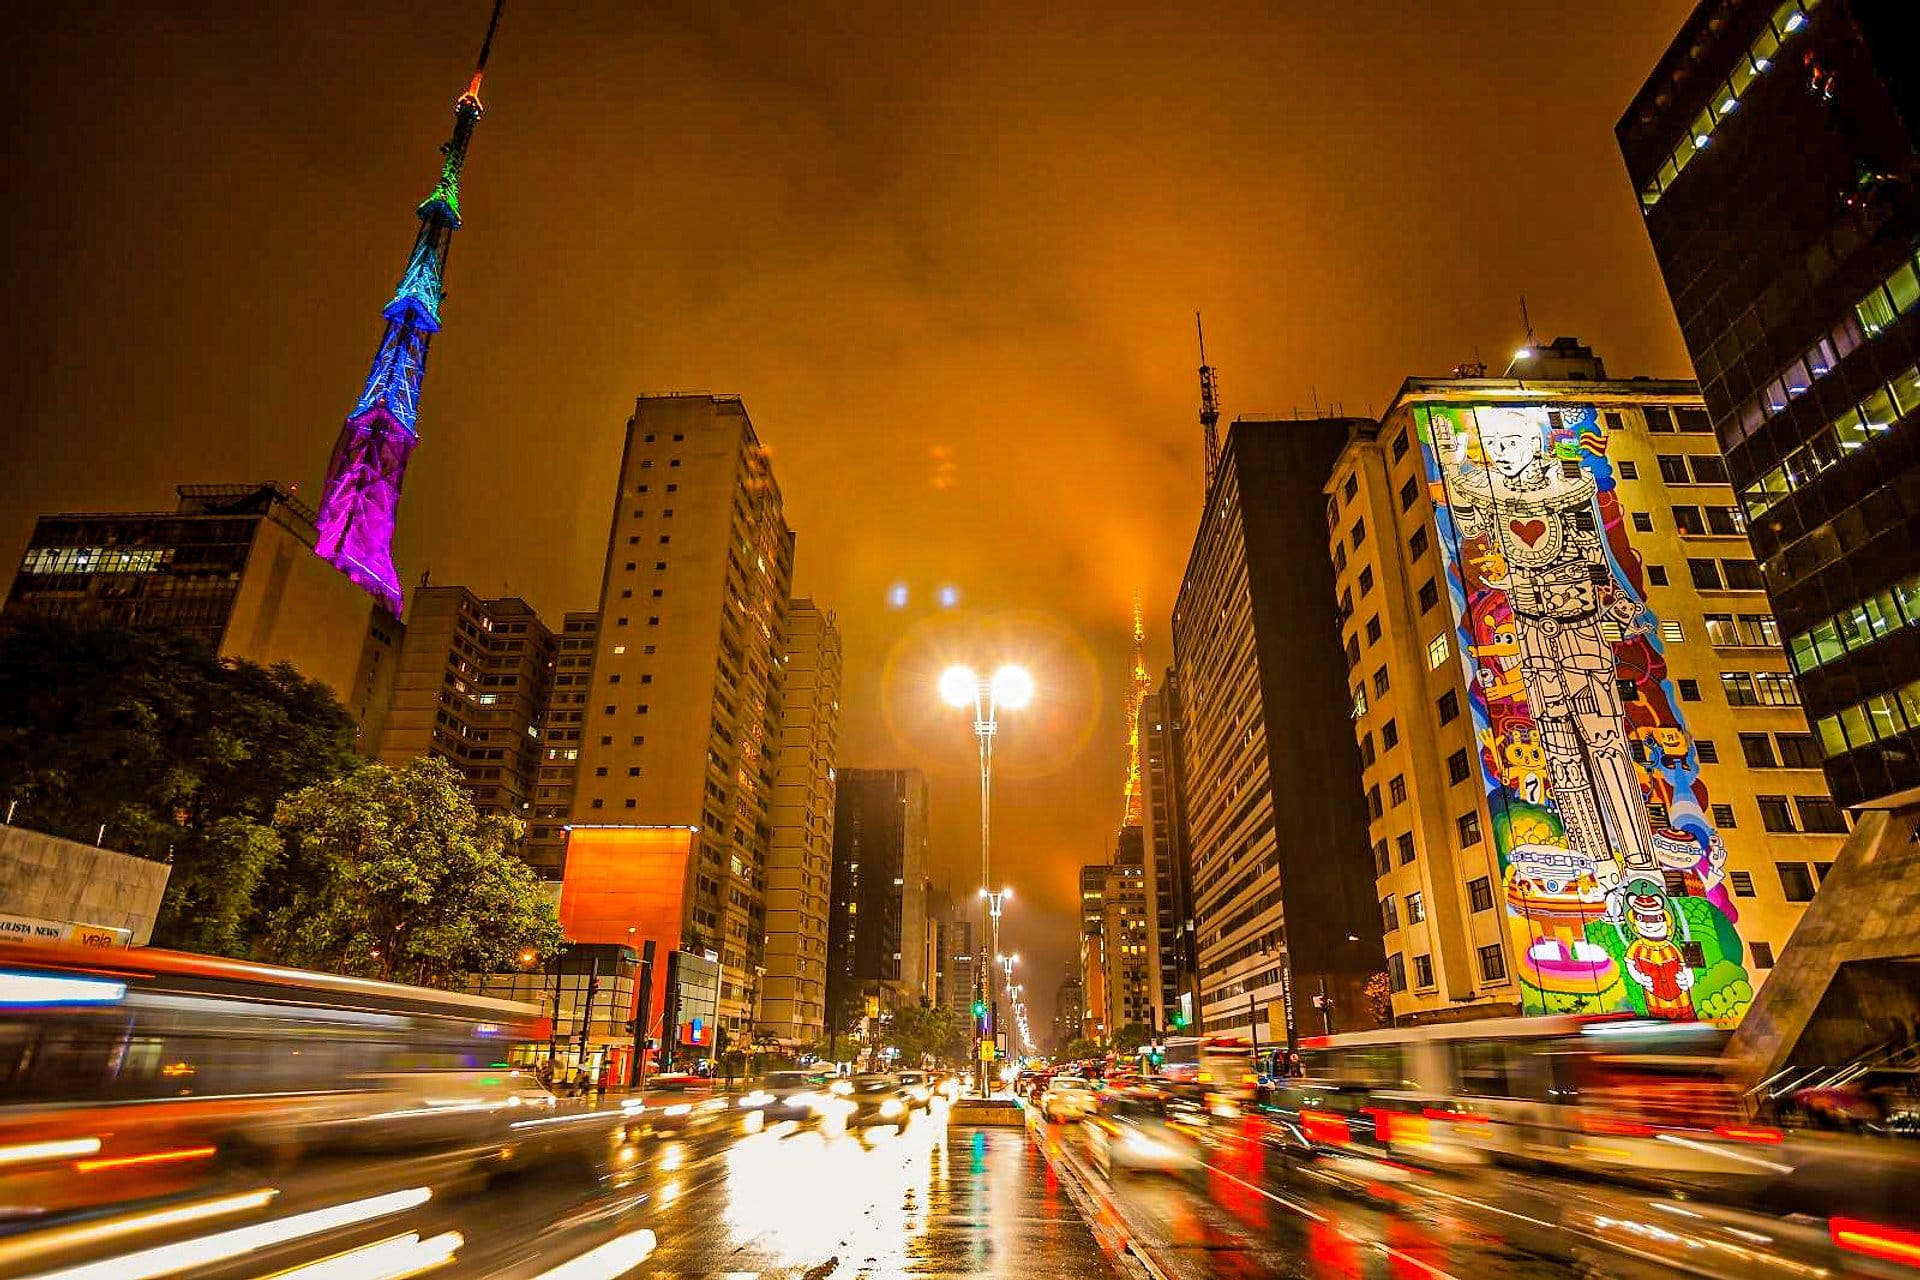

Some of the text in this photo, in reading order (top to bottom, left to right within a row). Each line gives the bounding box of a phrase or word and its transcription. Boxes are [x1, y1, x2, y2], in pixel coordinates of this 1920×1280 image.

[1525, 778, 1538, 802] 7
[0, 921, 60, 937] ULISTA NEWS
